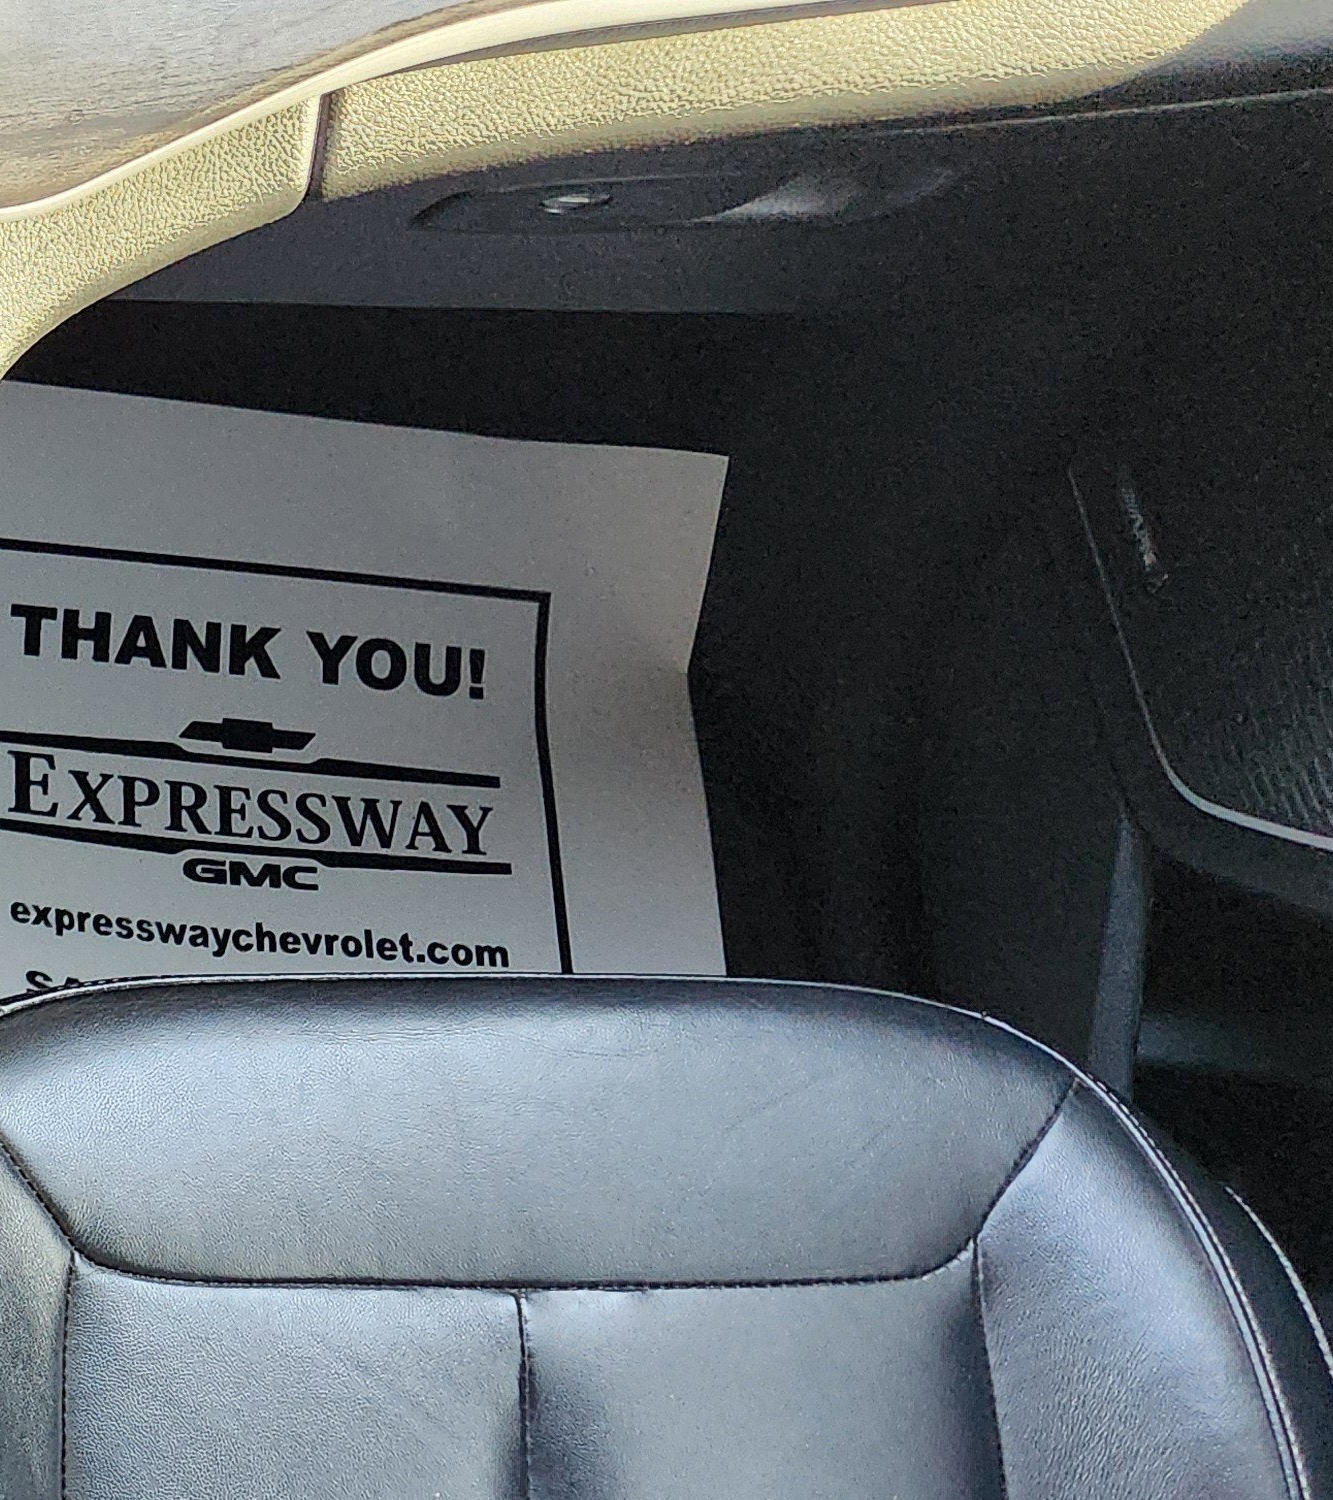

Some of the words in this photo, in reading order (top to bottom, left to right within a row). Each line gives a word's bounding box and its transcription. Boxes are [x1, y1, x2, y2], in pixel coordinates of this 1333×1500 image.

[10, 603, 282, 679] THANK
[305, 632, 486, 700] YOU!
[6, 748, 494, 856] EXPRESSWAY
[181, 857, 319, 891] GMC
[9, 900, 510, 969] expresswaychevrolet.com
